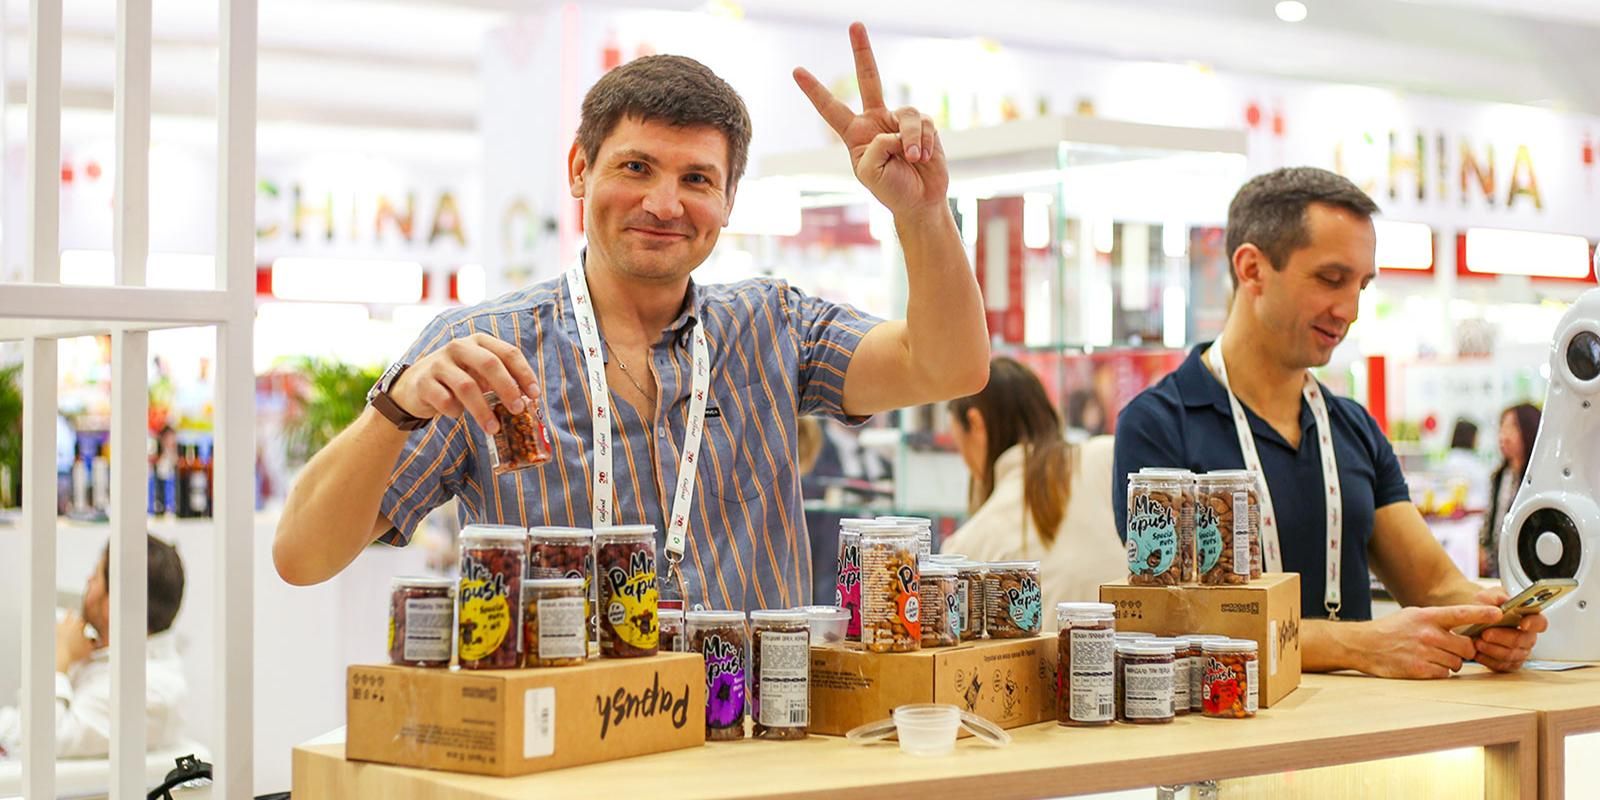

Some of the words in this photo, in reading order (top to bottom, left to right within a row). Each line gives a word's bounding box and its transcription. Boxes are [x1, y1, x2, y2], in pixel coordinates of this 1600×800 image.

[1333, 133, 1542, 209] CHINA
[1134, 495, 1166, 517] Mr.
[1128, 508, 1175, 537] apush
[462, 573, 509, 608] push
[608, 567, 657, 603] Papu
[1008, 588, 1041, 609] Papus
[703, 636, 737, 660] Mr.
[596, 670, 689, 740] Papush
